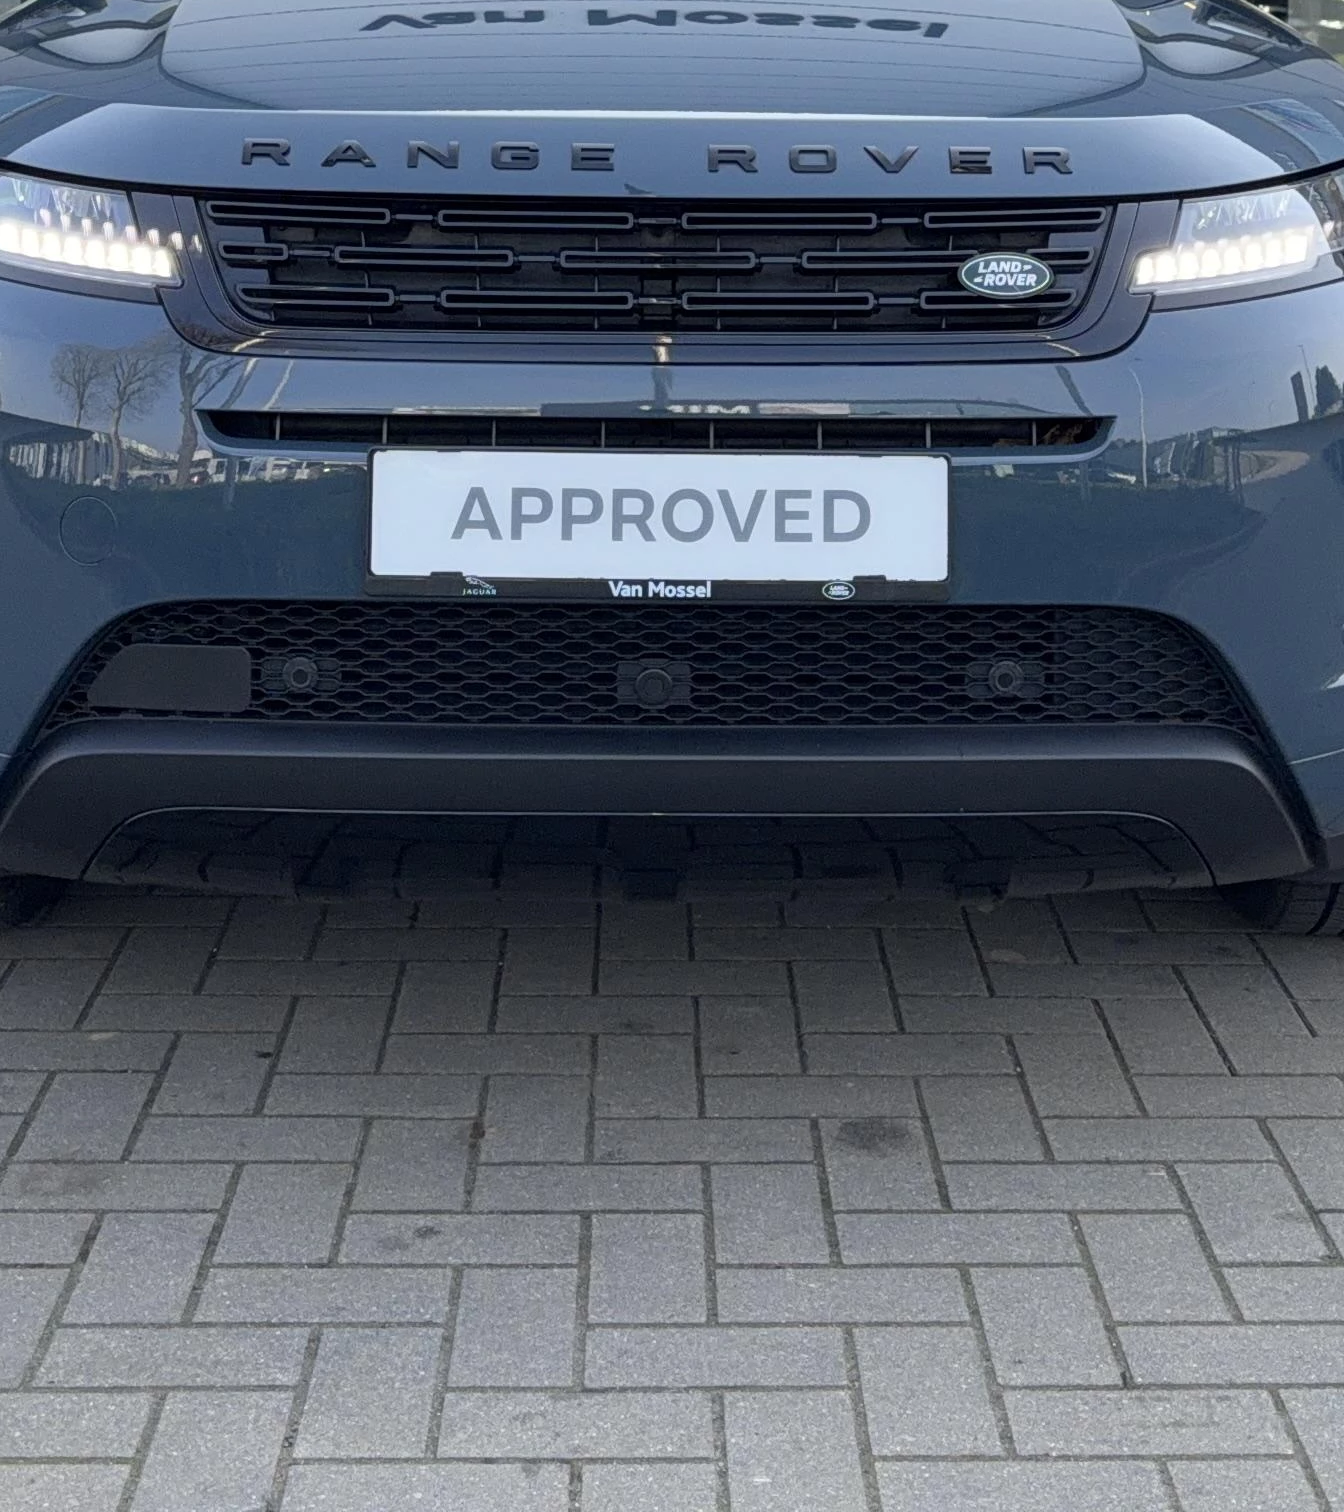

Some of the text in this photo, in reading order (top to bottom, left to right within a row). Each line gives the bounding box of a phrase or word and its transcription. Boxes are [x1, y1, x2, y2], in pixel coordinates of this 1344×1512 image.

[241, 138, 1074, 175] RANGE ROVER
[977, 260, 1022, 274] LAND
[983, 273, 1038, 287] ROVER
[450, 486, 872, 543] APPROVED
[608, 580, 712, 598] Van Mossel
